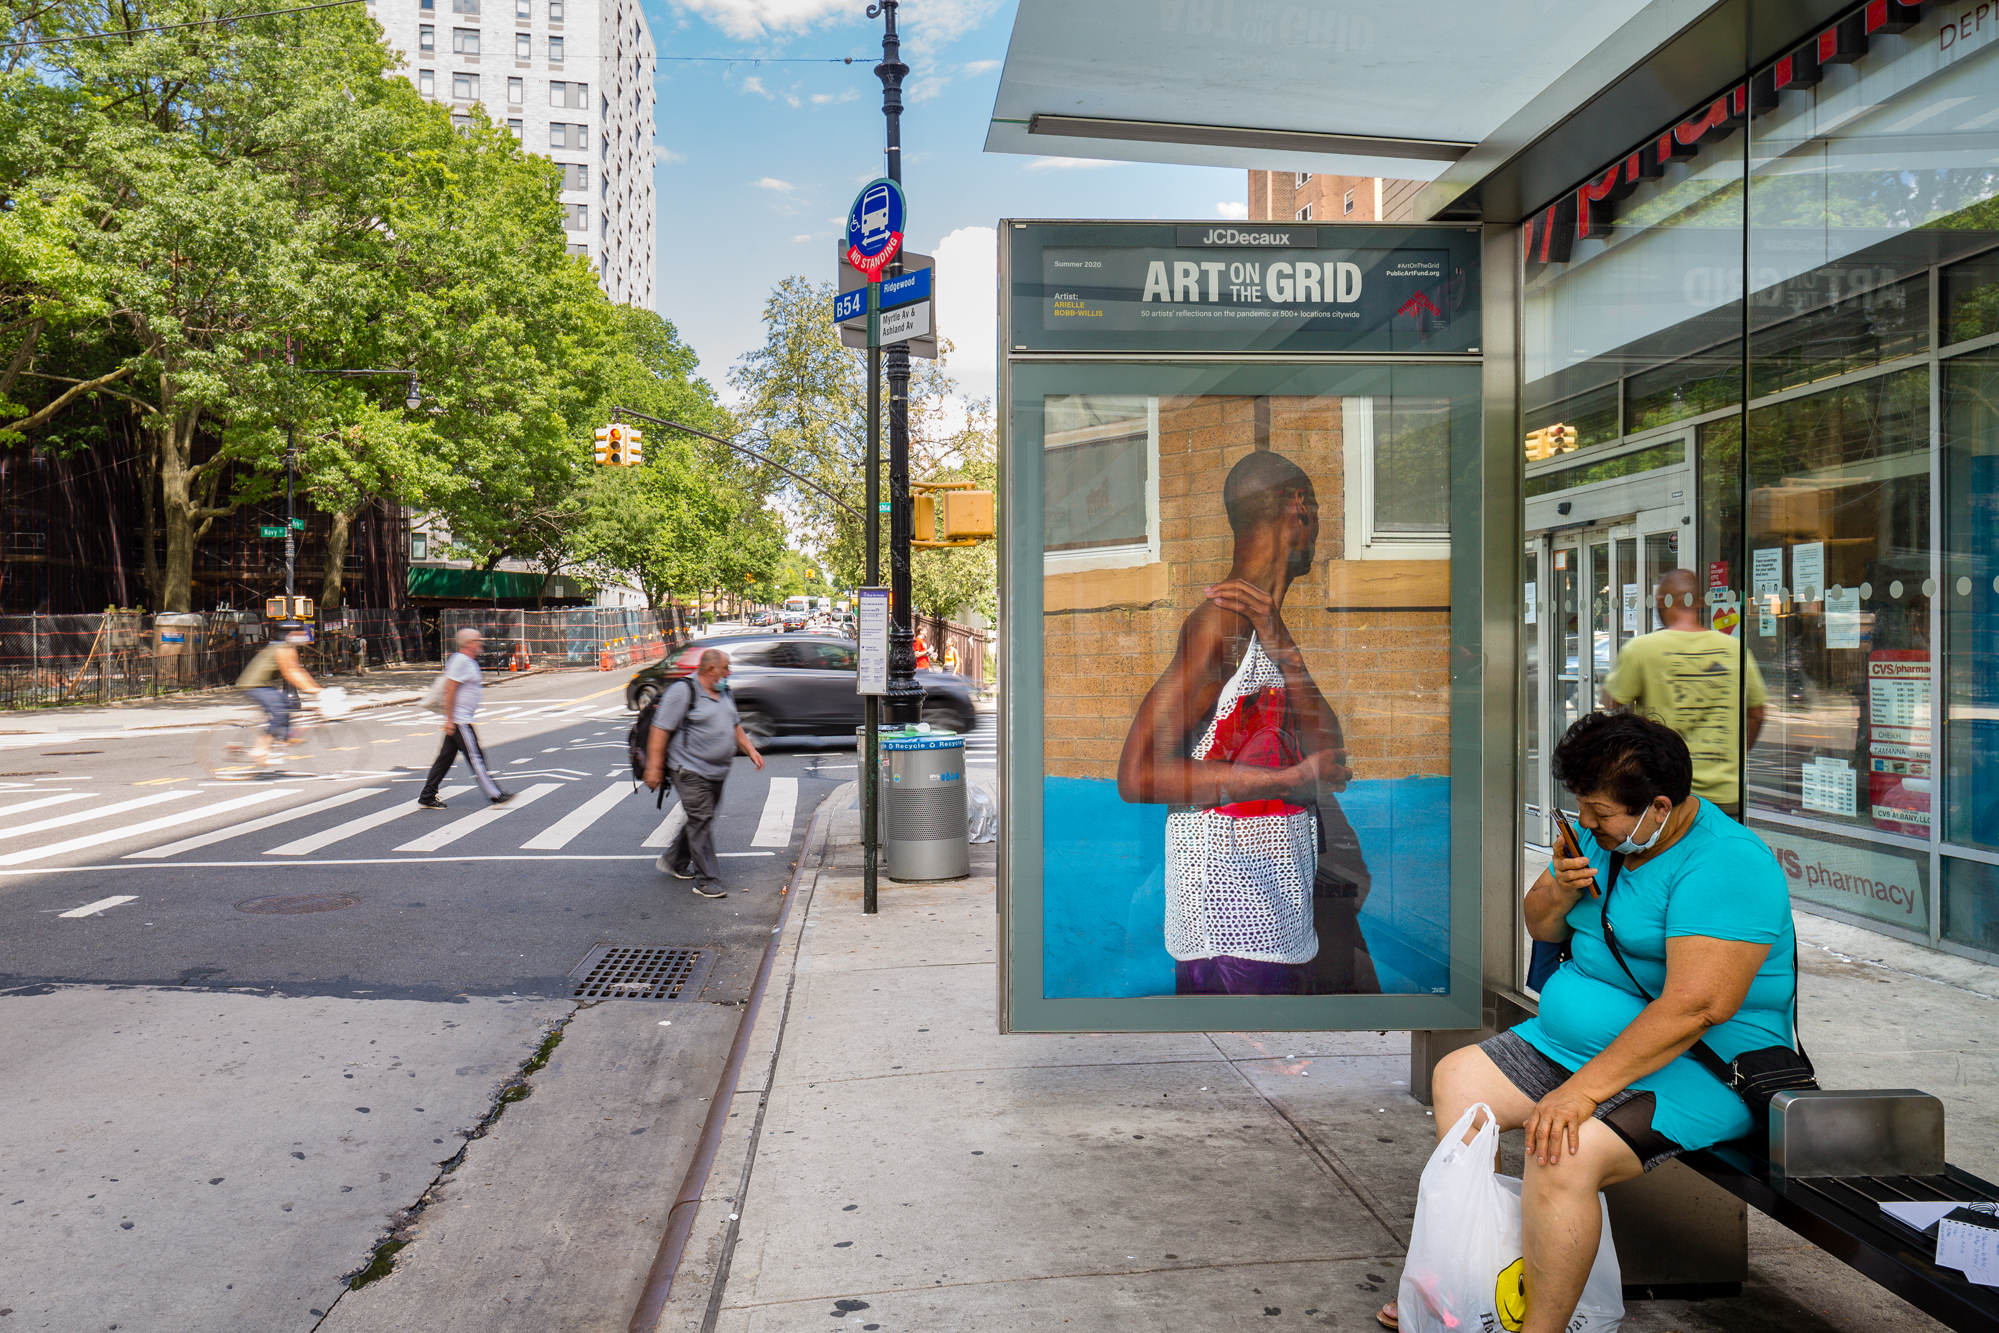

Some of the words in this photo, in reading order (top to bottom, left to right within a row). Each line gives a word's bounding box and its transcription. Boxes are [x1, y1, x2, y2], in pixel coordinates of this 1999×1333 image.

[1203, 229, 1290, 245] JCDecaux
[850, 250, 861, 265] NO
[861, 238, 898, 269] STANDING
[1142, 261, 1226, 302] ART
[1230, 262, 1260, 284] ON
[884, 276, 915, 293] Ridgewood
[1266, 262, 1362, 303] GRID
[1230, 286, 1261, 302] THE
[836, 294, 860, 318] B54
[1398, 290, 1424, 317] PUBLIC
[1422, 296, 1441, 317] FUND
[883, 313, 900, 325] Myrtle
[902, 310, 910, 319] Av
[911, 308, 916, 317] &
[1237, 310, 1271, 318] pandemic
[1300, 310, 1331, 318] locations
[1332, 311, 1360, 319] citywide
[882, 322, 905, 337] Ashland
[906, 322, 914, 331] Av
[264, 529, 278, 537] Navy
[1878, 732, 1902, 740] CHEIKH
[1874, 747, 1906, 755] TAMANNA
[1878, 810, 1891, 818] CVS
[1892, 812, 1918, 823] ALBANY,
[1768, 846, 1803, 880] VS
[1806, 861, 1914, 914] pharmacy
